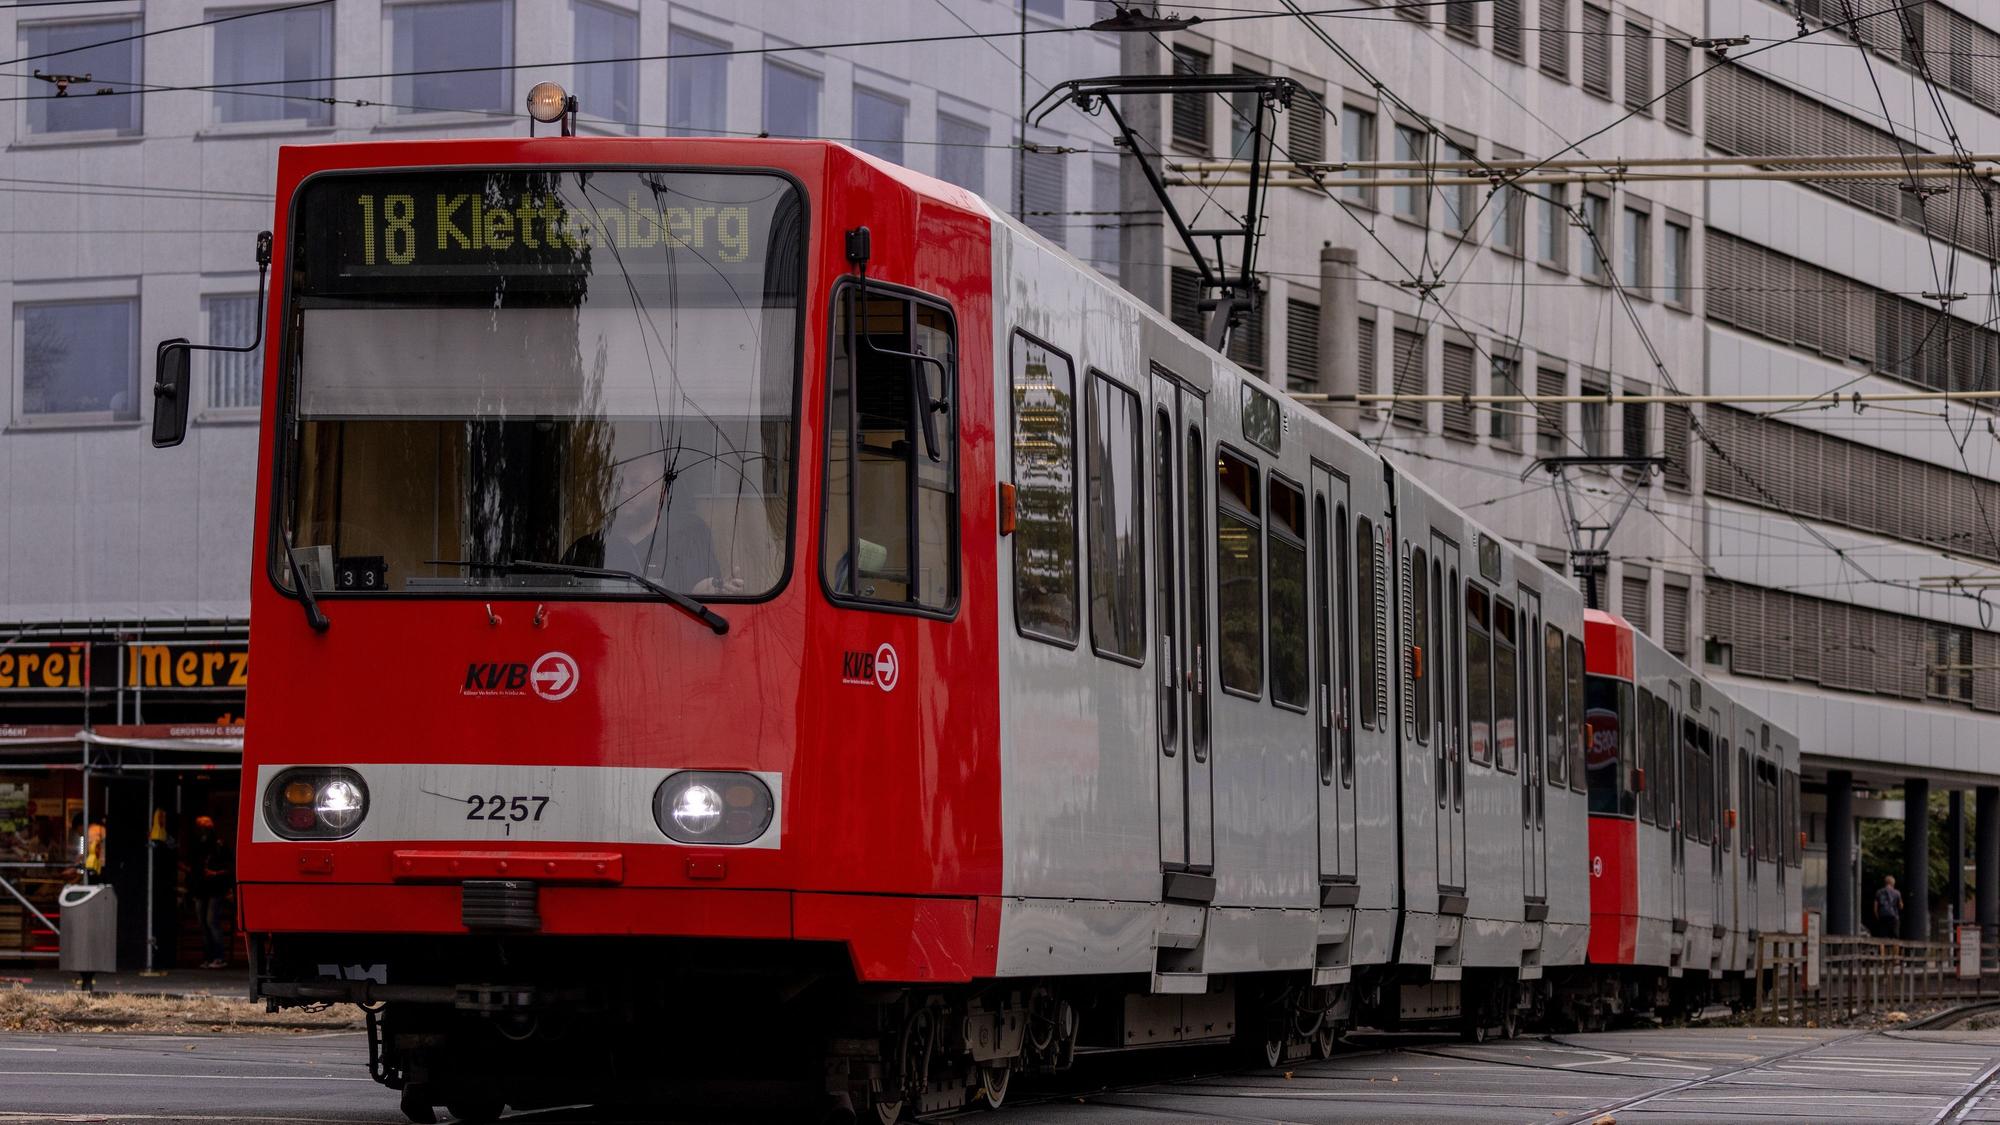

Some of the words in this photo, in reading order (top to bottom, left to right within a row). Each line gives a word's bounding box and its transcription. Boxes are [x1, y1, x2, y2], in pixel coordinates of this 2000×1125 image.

[358, 194, 416, 265] 18
[436, 192, 749, 263] Klettenberg
[0, 643, 81, 687] erei
[128, 645, 248, 686] Merz
[465, 663, 529, 689] KVB
[842, 651, 875, 679] KVB
[467, 795, 550, 822] 2257
[504, 823, 511, 836] 1
